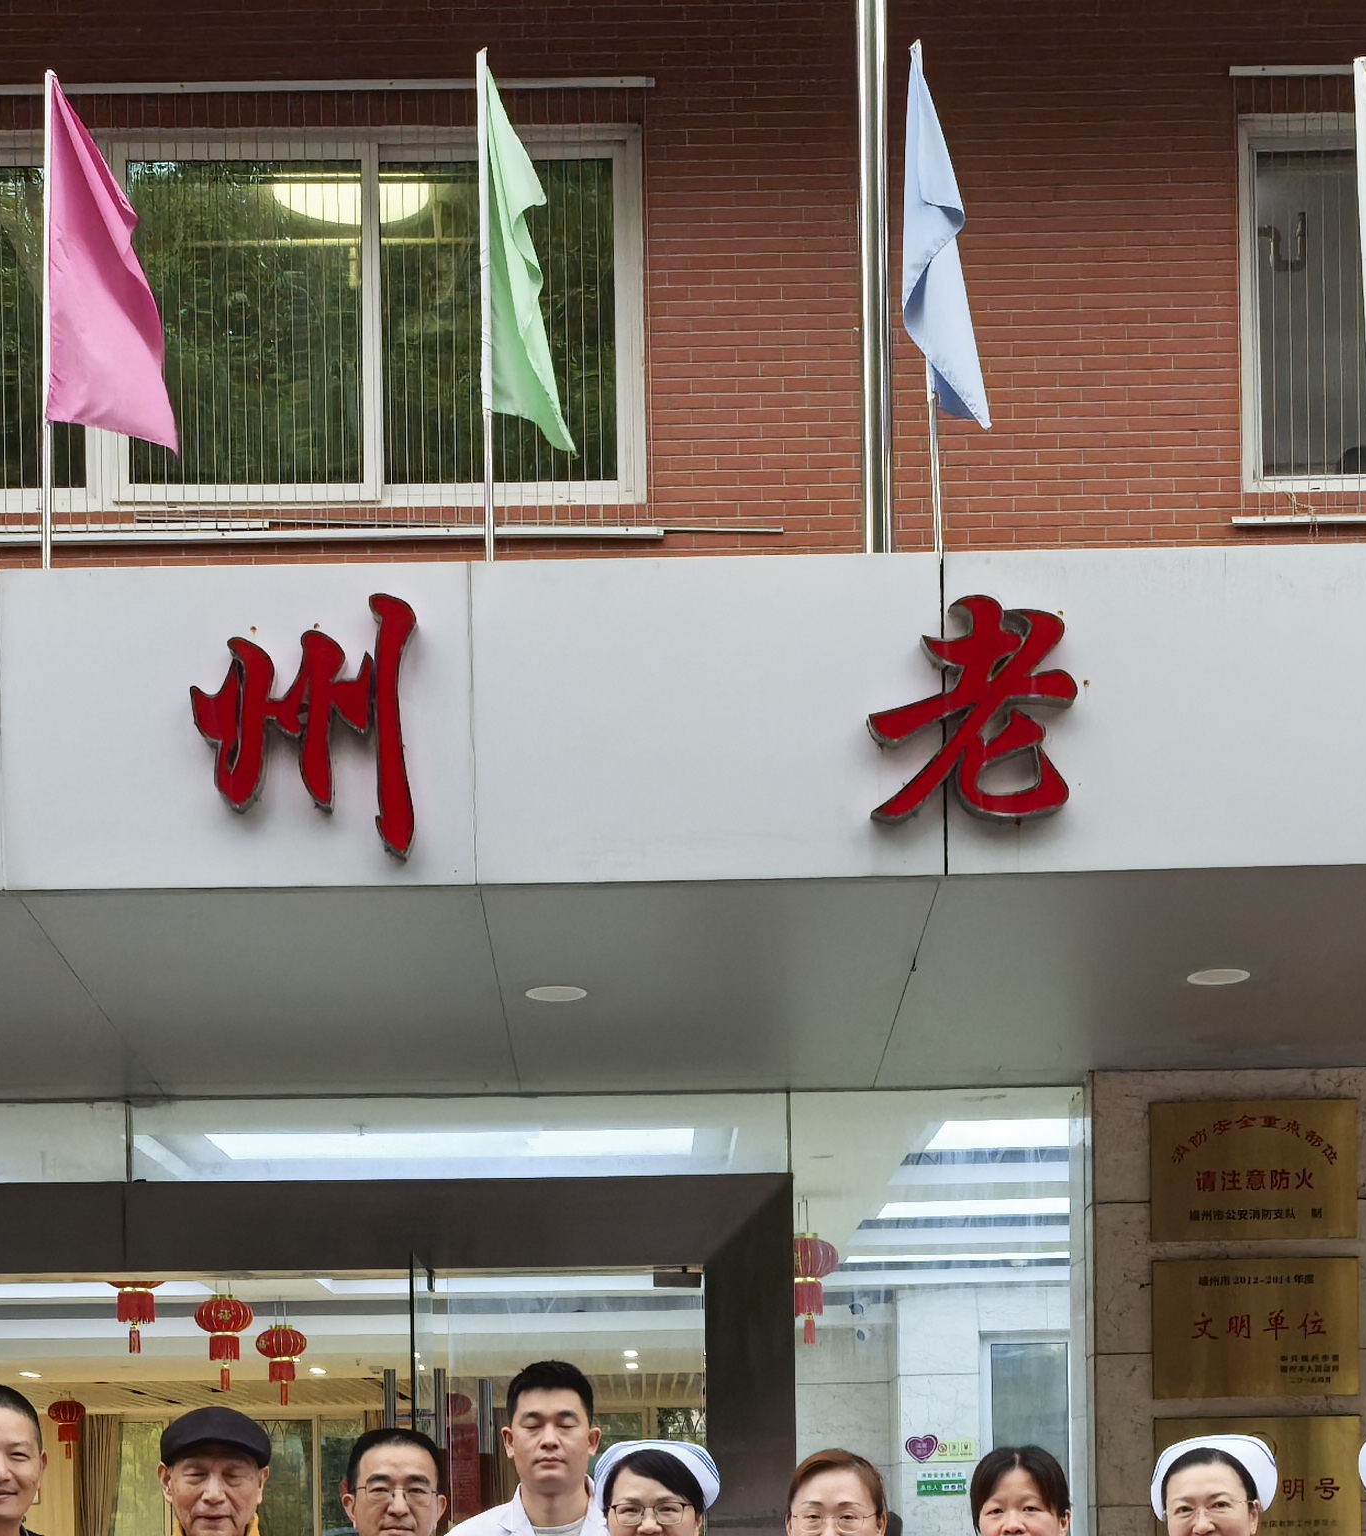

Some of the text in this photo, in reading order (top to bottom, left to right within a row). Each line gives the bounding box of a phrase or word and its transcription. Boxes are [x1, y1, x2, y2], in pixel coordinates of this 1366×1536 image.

[1171, 1115, 1338, 1166] 消防安全重点部位
[1196, 1168, 1314, 1192] 请注意防火
[1191, 1309, 1327, 1341] 文明单位
